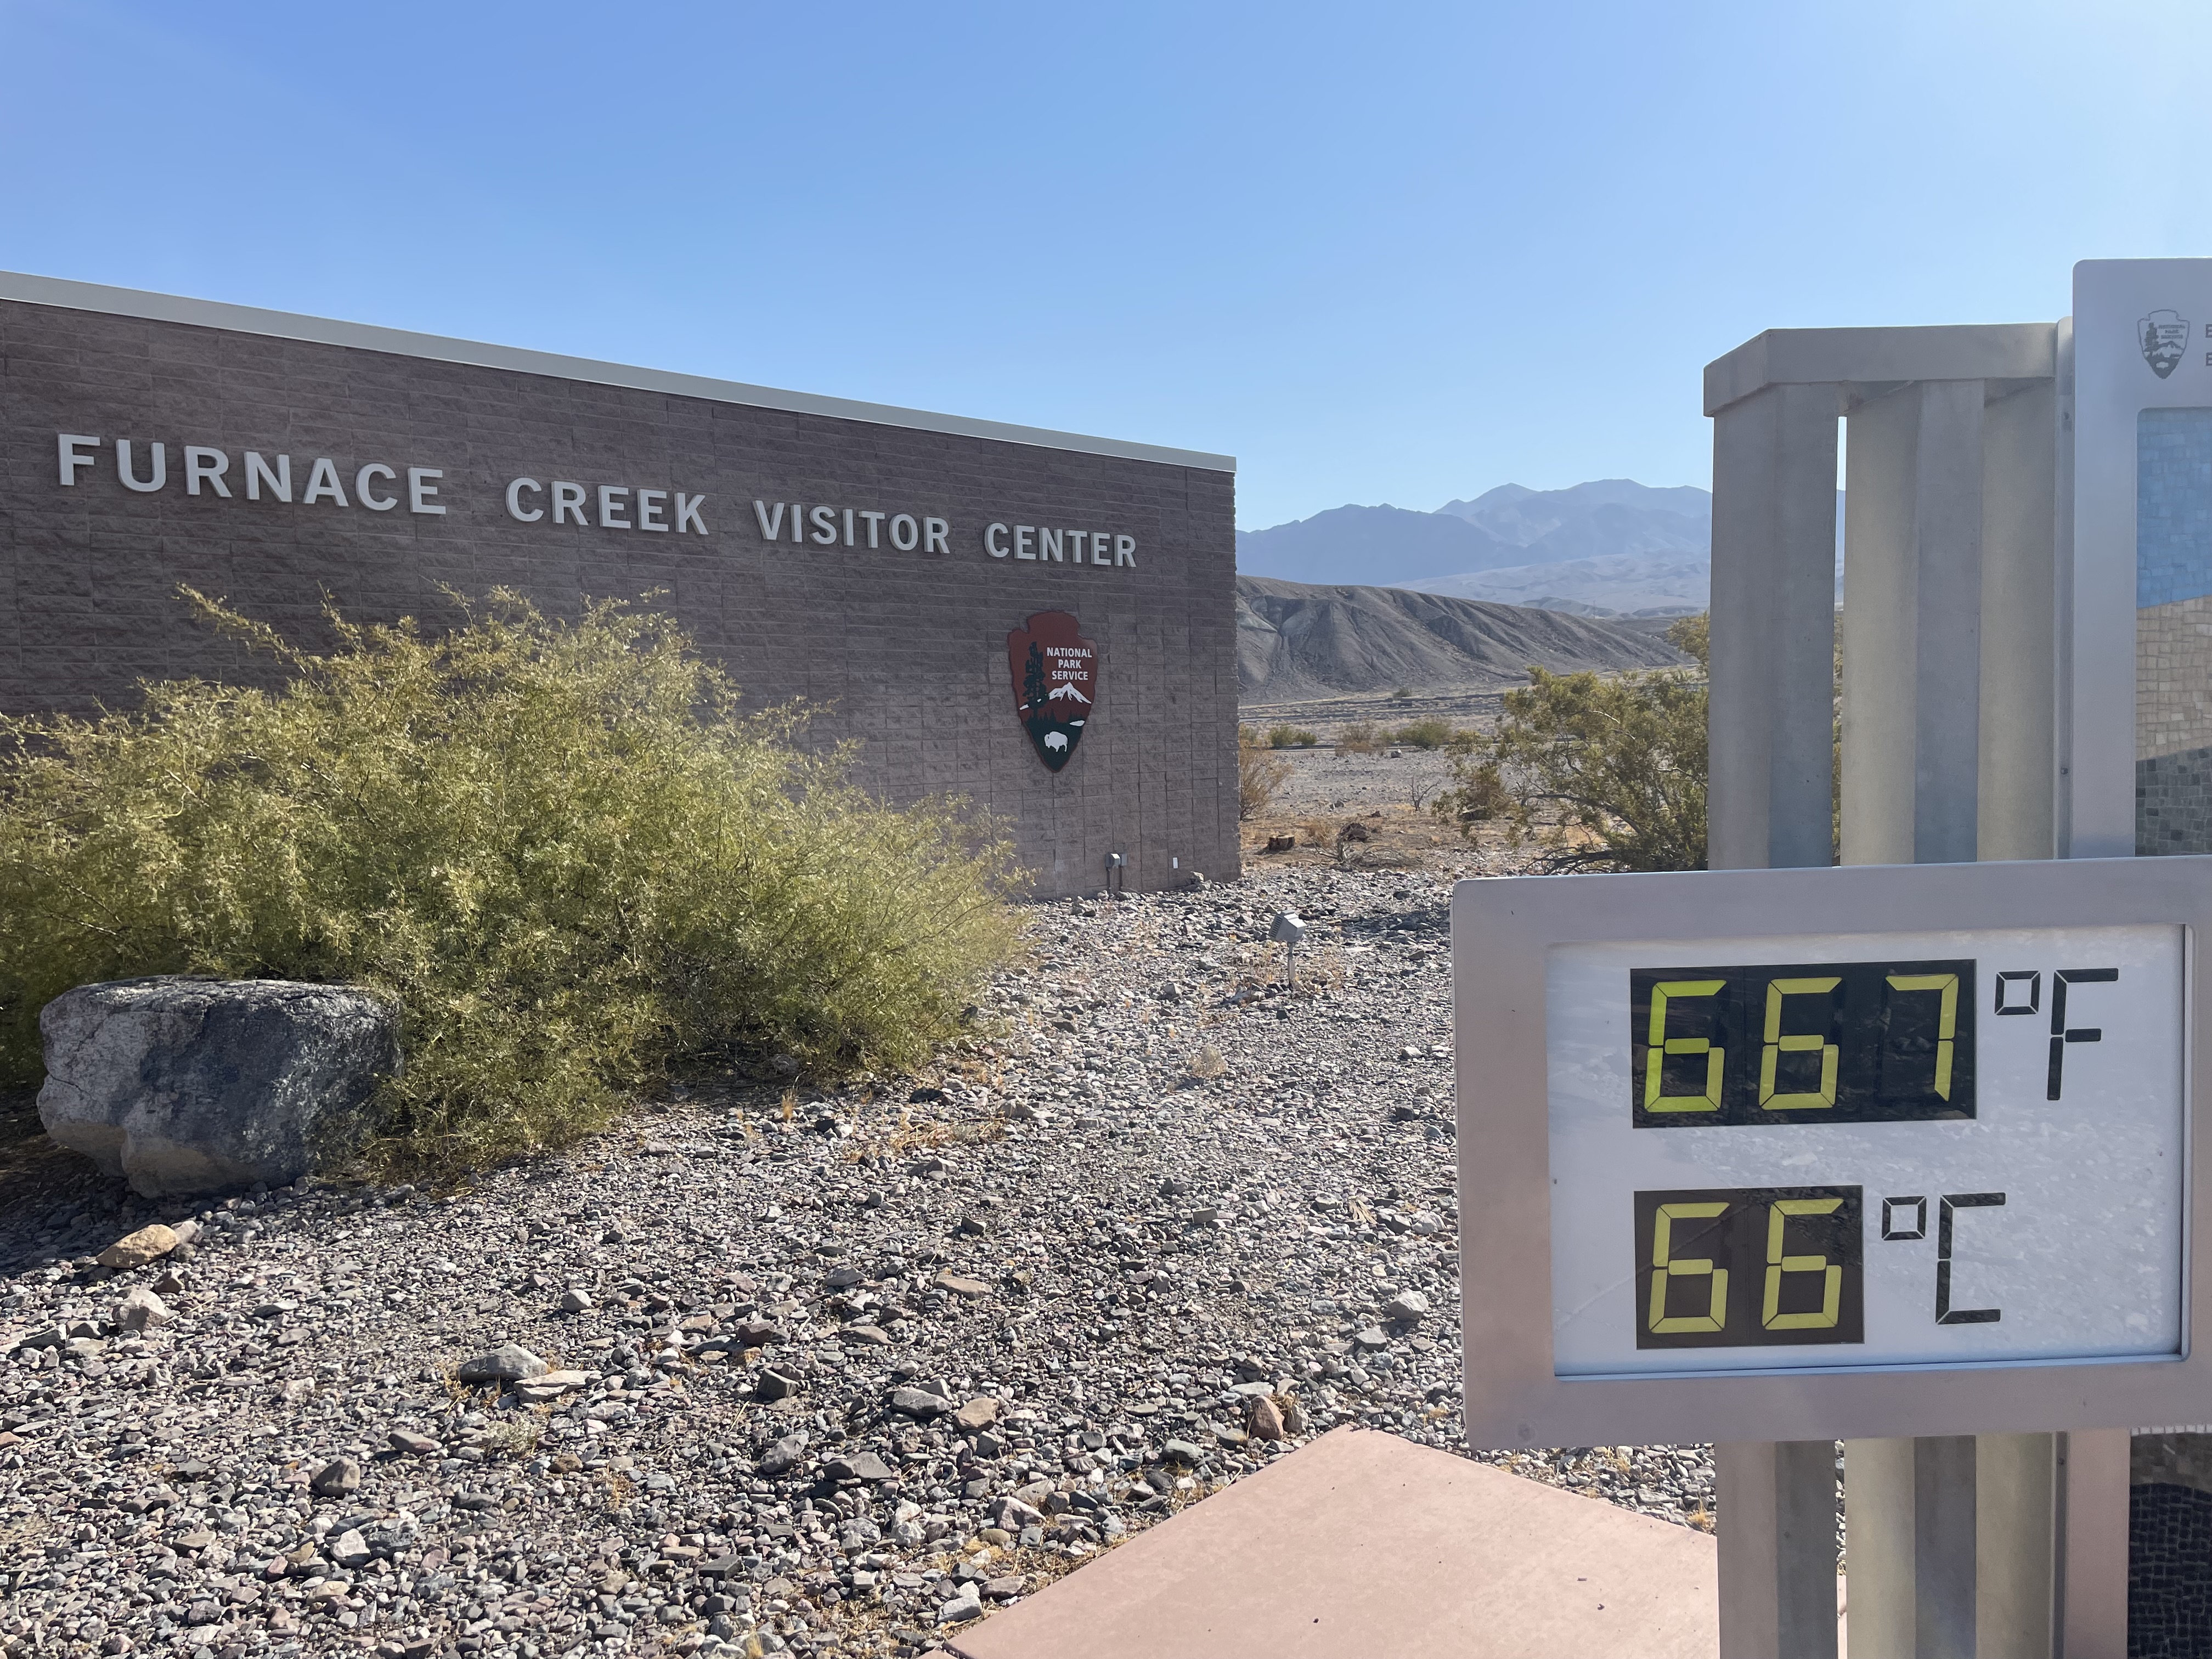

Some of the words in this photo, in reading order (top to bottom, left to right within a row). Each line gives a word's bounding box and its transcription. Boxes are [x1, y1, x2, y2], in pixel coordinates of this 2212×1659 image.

[58, 433, 447, 515] FURNACE
[506, 477, 709, 535] CREEK
[752, 500, 950, 554] VISITOR
[984, 522, 1136, 567] CENTER
[1047, 647, 1092, 658] NATIONAL
[1052, 670, 1088, 681] SERVICE
[1058, 659, 1082, 669] PARK
[1645, 973, 1959, 1113] 667
[1648, 1198, 1844, 1333] 66
